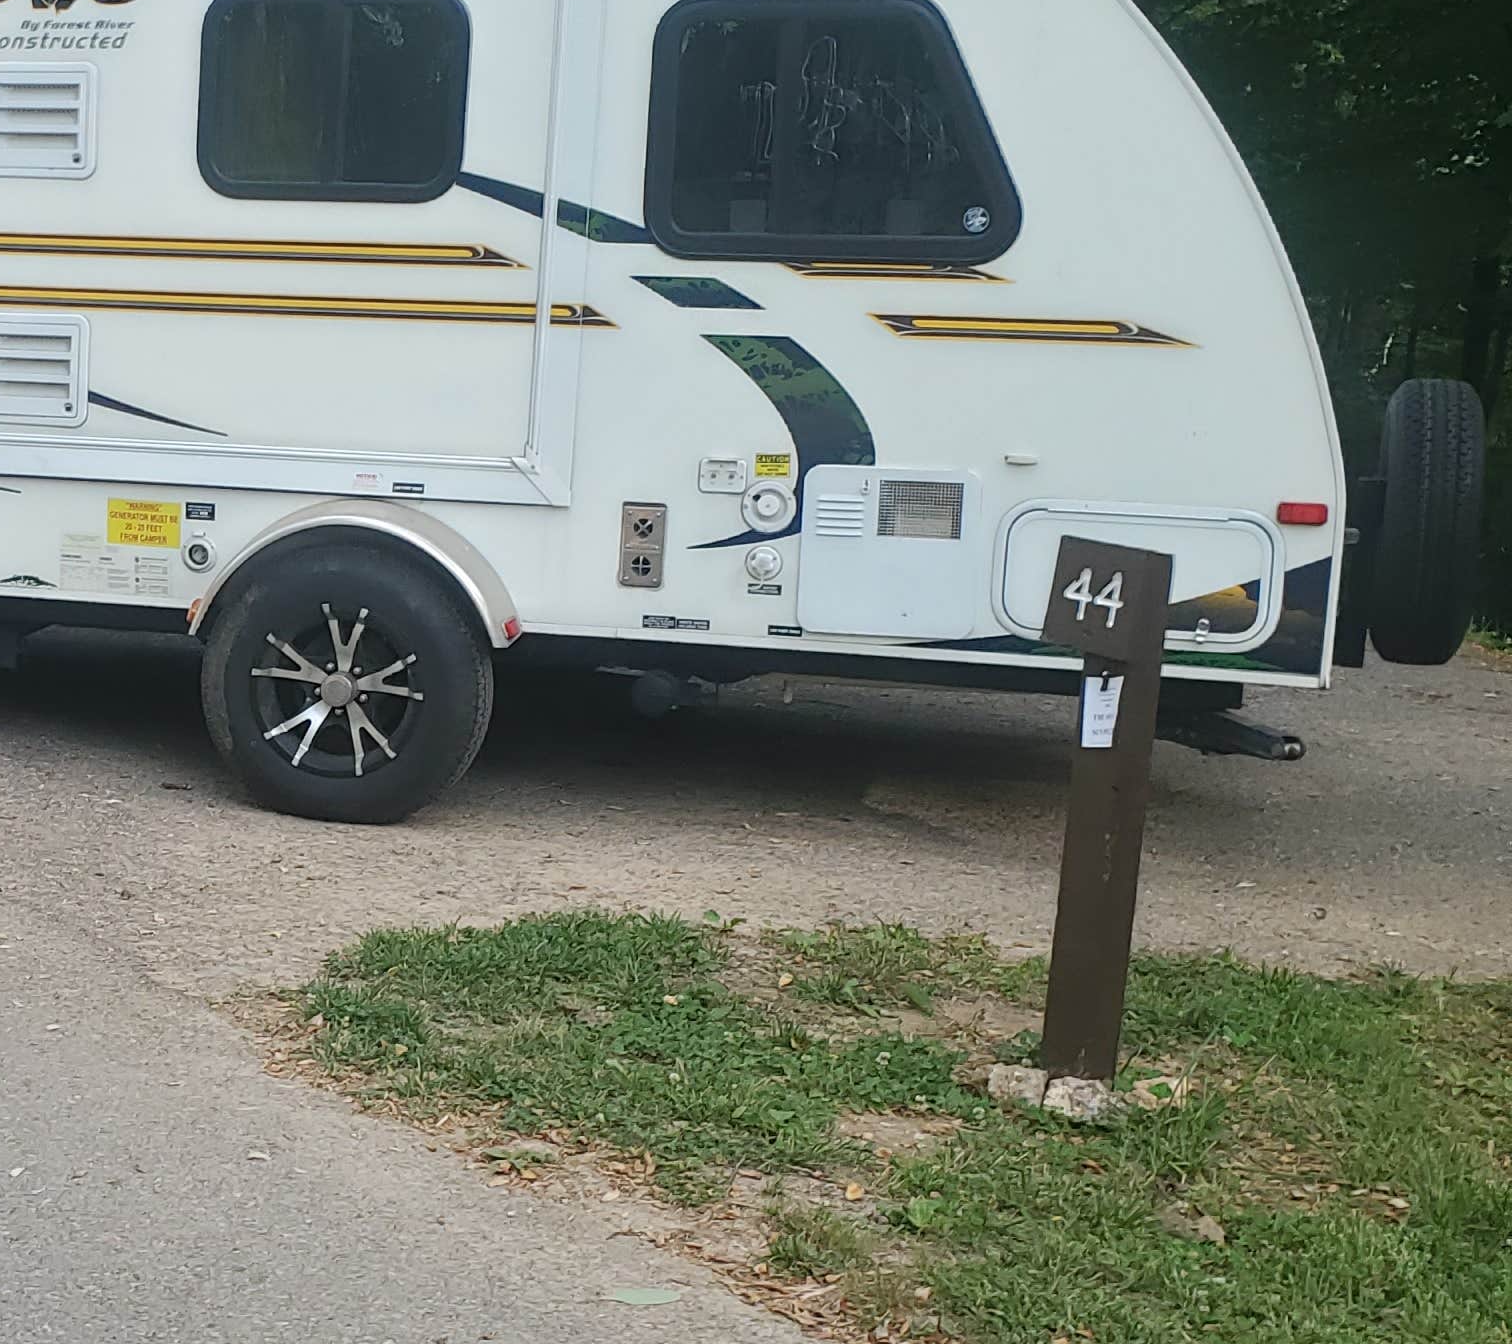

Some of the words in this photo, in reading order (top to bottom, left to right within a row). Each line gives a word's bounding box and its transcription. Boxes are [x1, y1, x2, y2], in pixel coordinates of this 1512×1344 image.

[43, 19, 91, 30] Forest
[94, 19, 136, 30] River
[1063, 567, 1124, 628] 44
